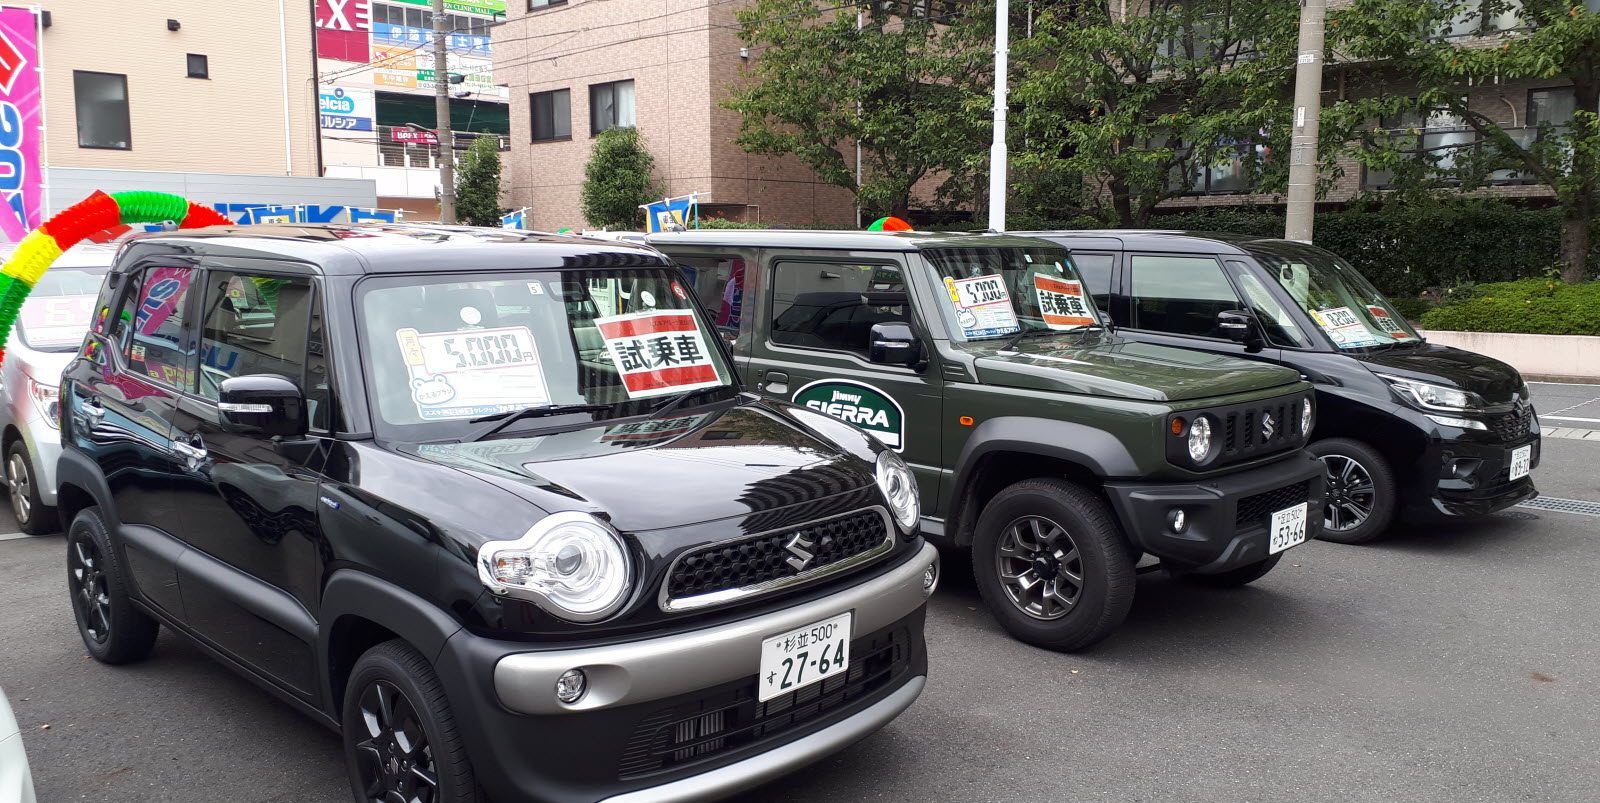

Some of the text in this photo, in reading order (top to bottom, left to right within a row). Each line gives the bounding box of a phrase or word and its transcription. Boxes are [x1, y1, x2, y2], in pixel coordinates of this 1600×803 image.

[453, 4, 474, 13] CLINIC
[475, 7, 490, 15] MALL
[1039, 290, 1086, 317] 試乗車
[614, 335, 704, 372] 試乗車
[806, 399, 890, 428] SIERRA
[1278, 519, 1305, 548] 53-66
[783, 623, 833, 653] 杉並 500
[766, 638, 845, 690] す 27-64
